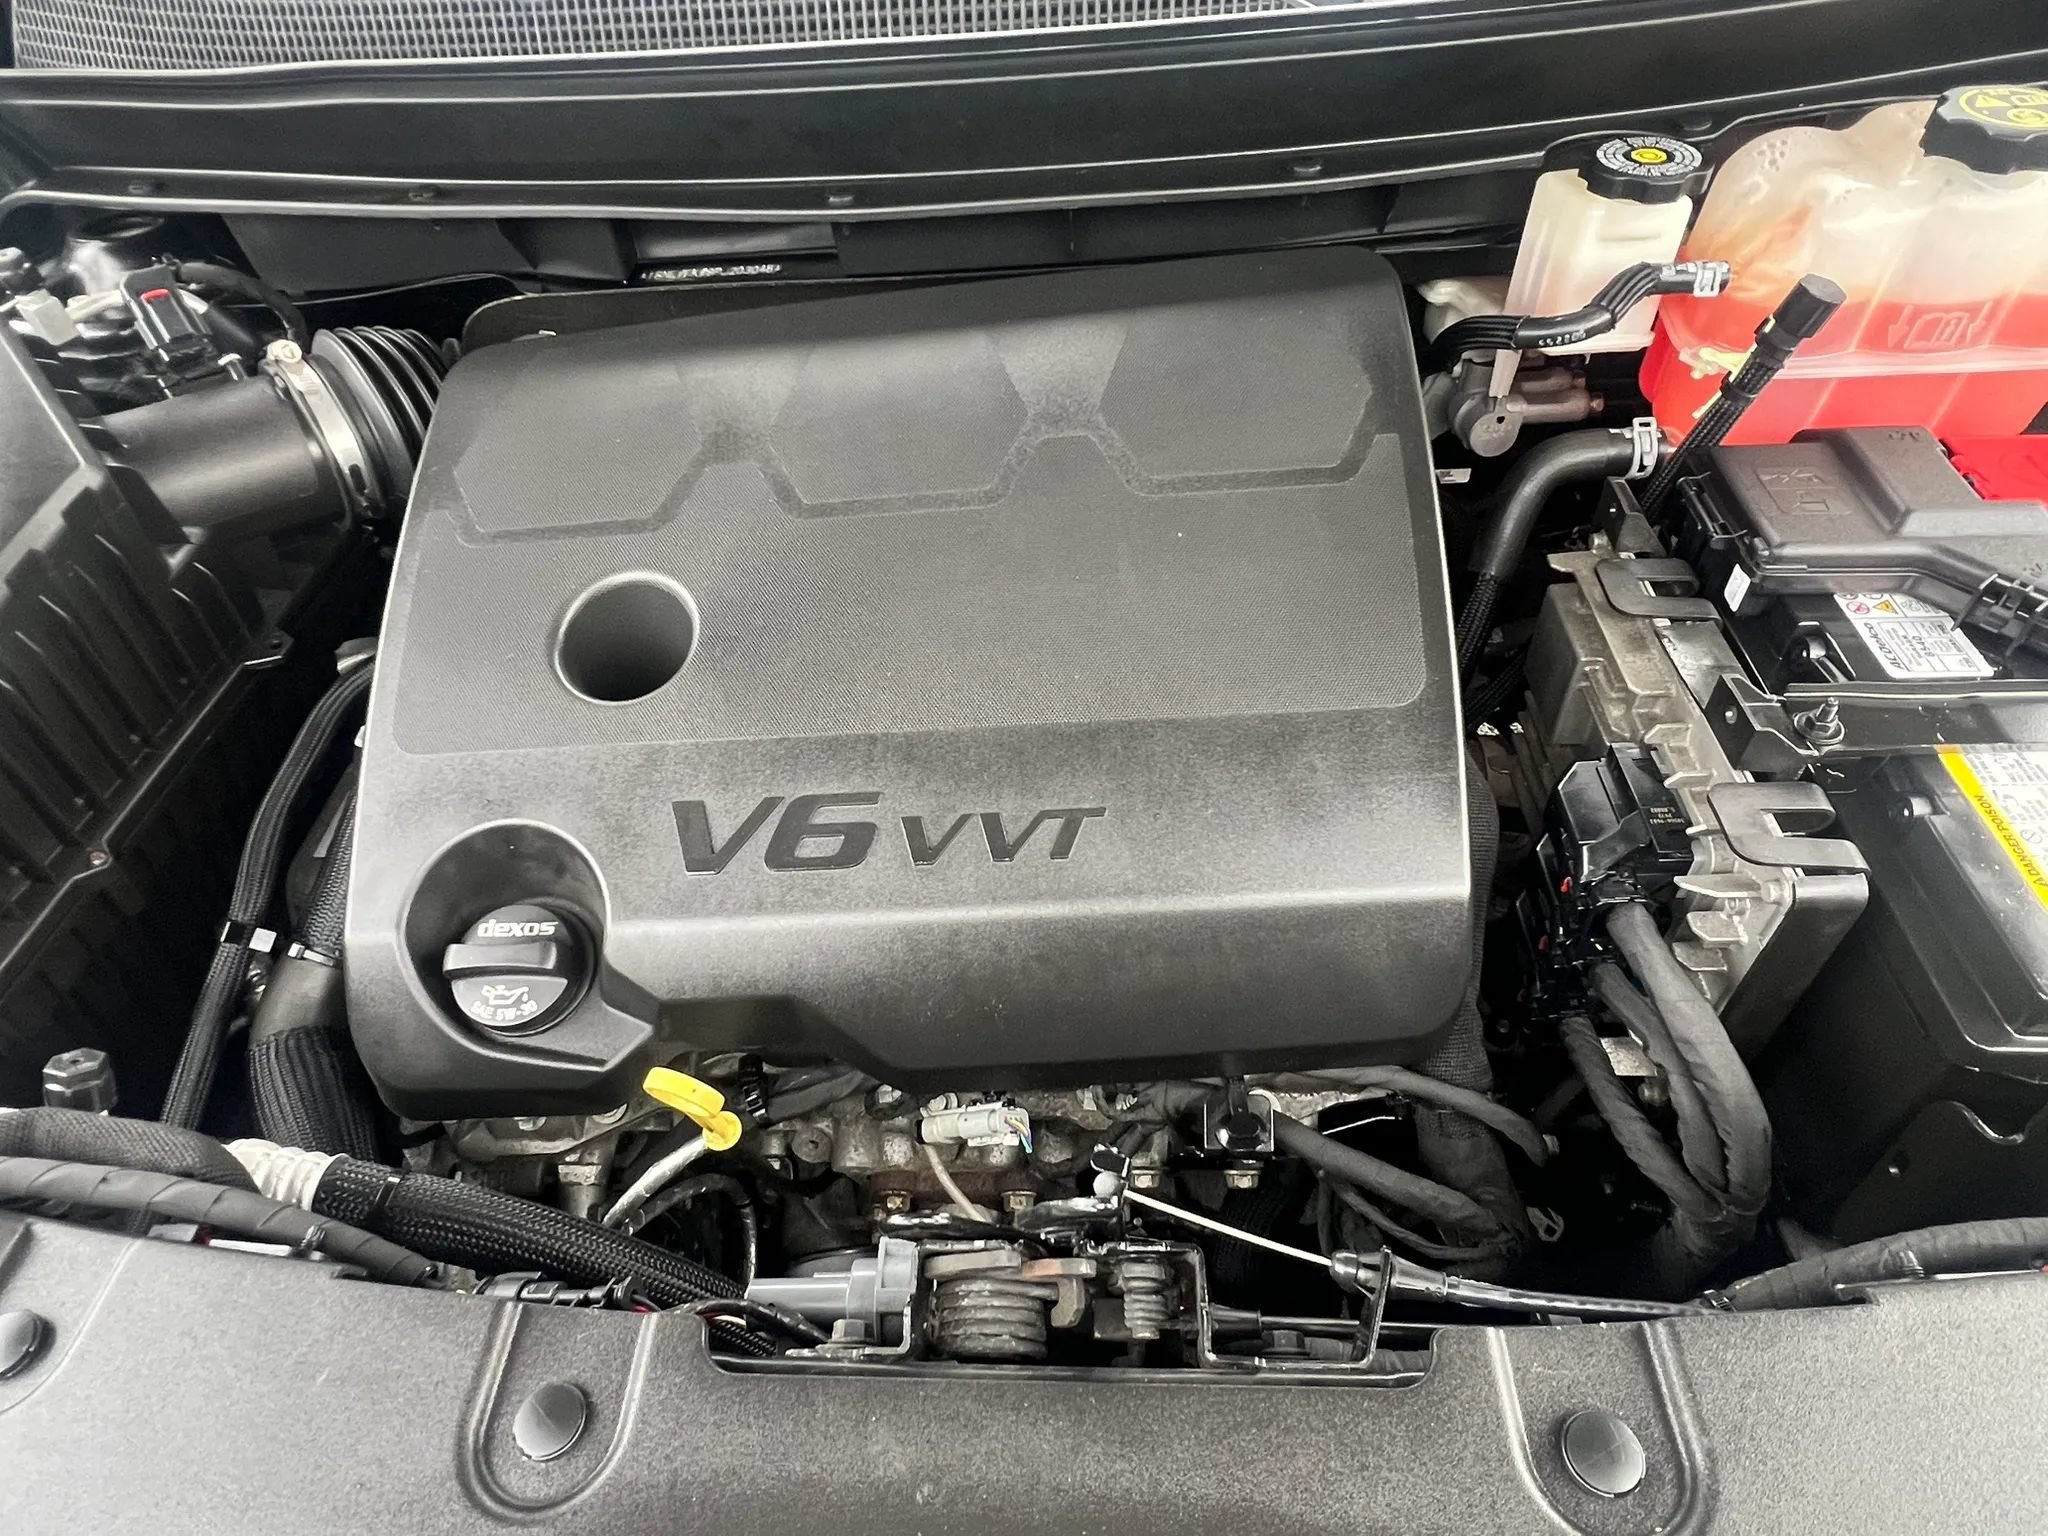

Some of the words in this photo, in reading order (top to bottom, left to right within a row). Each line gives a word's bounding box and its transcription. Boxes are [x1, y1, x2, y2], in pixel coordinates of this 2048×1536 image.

[1863, 622, 1905, 670] ACDelco
[672, 791, 882, 876] V6
[901, 807, 1107, 866] VVT
[477, 918, 559, 937] dexos
[470, 1000, 494, 1019] SAE
[496, 999, 538, 1021] 5W-30
